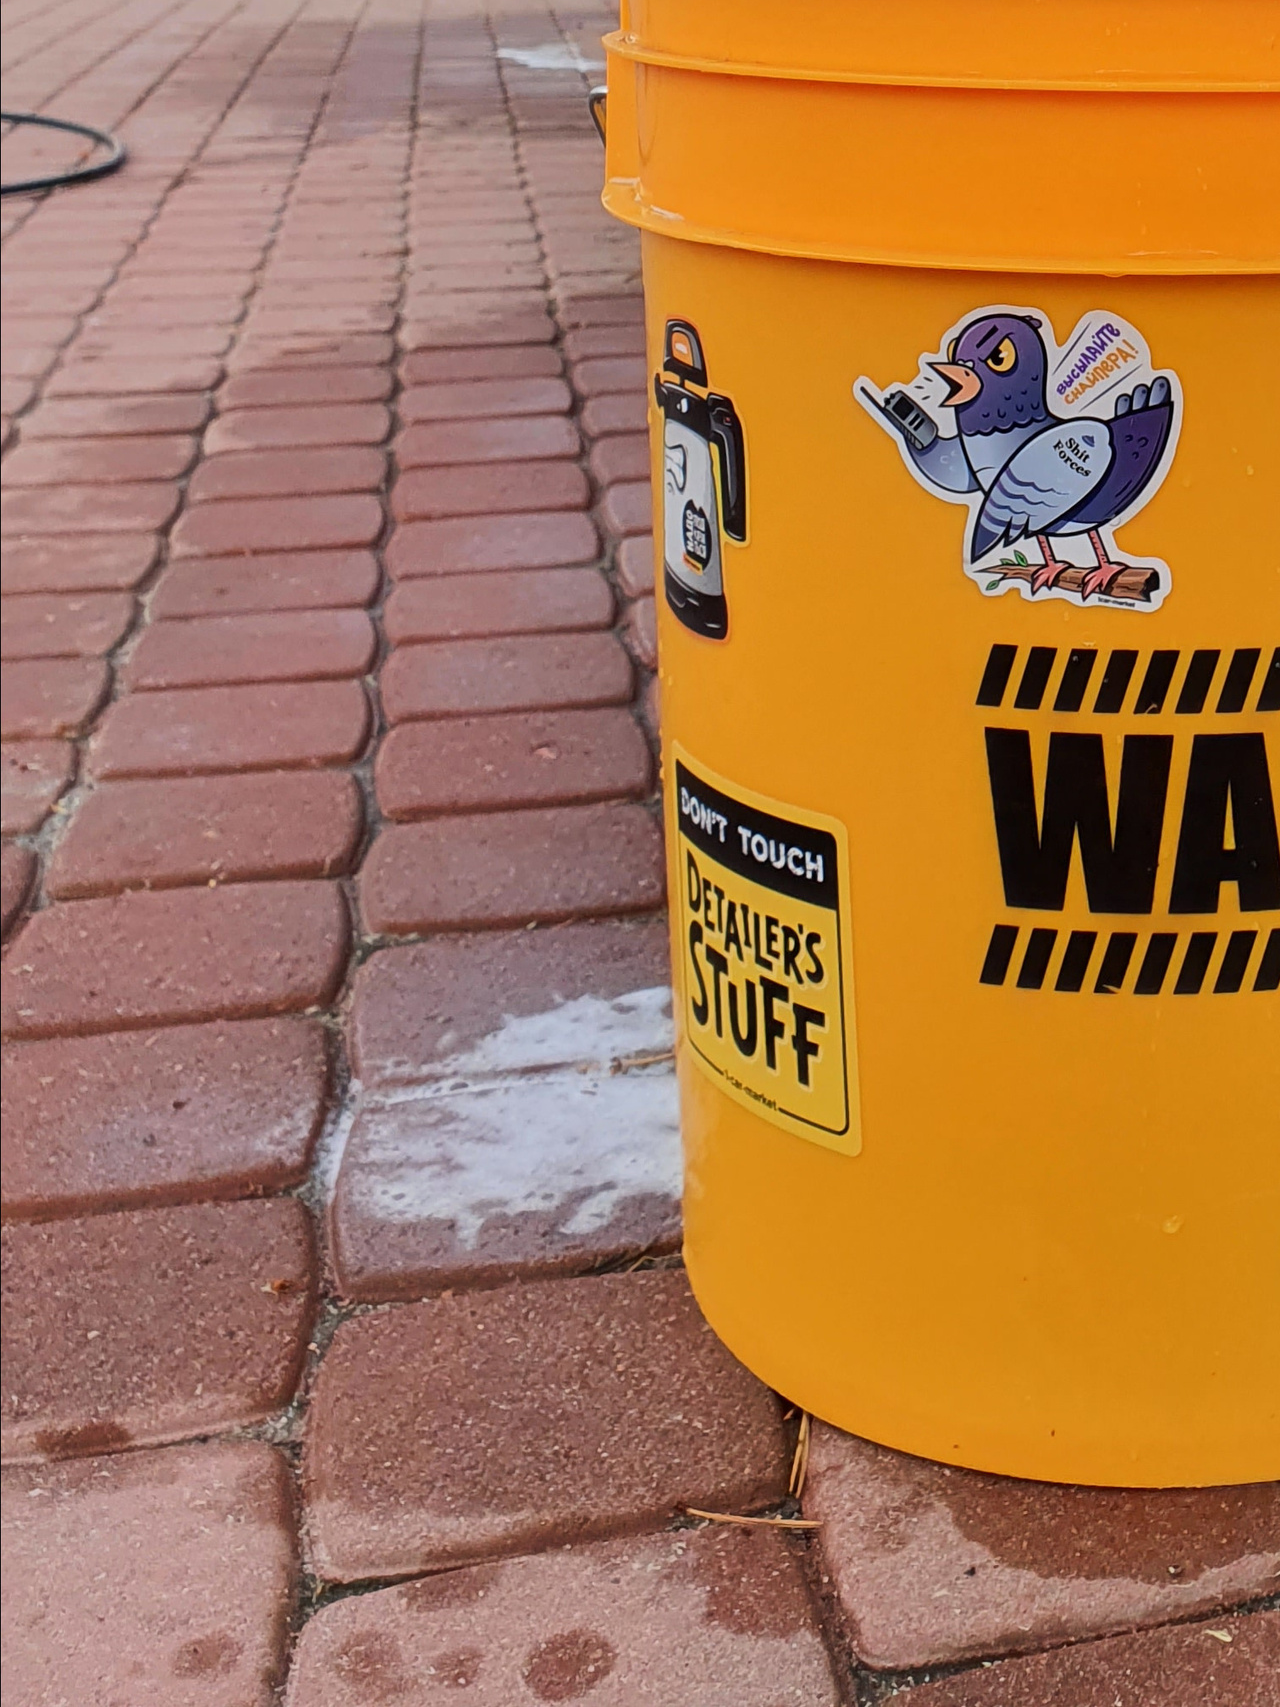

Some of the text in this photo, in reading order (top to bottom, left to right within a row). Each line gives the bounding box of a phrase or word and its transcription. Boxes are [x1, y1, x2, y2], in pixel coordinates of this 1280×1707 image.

[1056, 322, 1121, 395] ВЫСЫЛАЙТЕ
[1064, 339, 1139, 404] СНАЙПЕРА!
[1053, 439, 1091, 476] Forces
[1065, 437, 1090, 463] Shit
[681, 787, 824, 882] DON'T TOUCH
[687, 848, 824, 985] DETAILER'S
[689, 920, 825, 1086] STUFF
